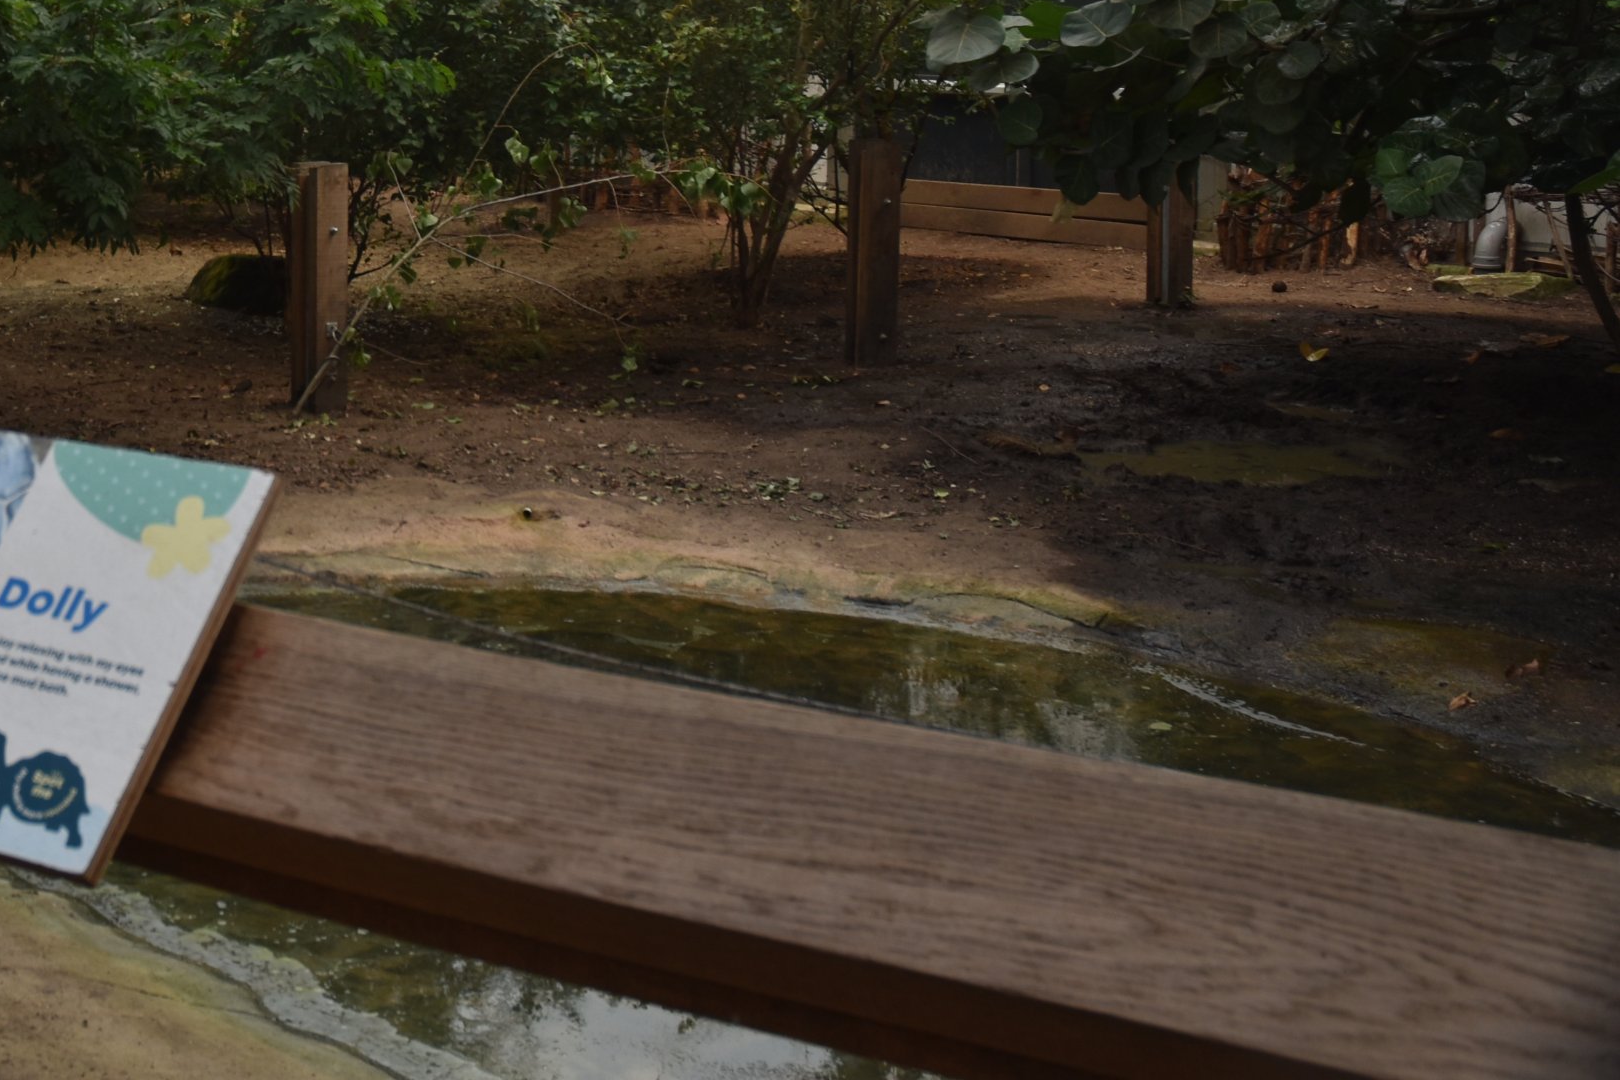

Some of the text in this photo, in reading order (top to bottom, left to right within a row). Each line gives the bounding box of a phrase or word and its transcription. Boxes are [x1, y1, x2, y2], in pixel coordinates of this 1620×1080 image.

[9, 657, 39, 671] while
[42, 663, 82, 684] having
[17, 641, 65, 662] relaxing
[67, 652, 94, 666] with
[96, 659, 113, 673] my
[115, 663, 144, 678] eyes
[11, 674, 37, 690] mud
